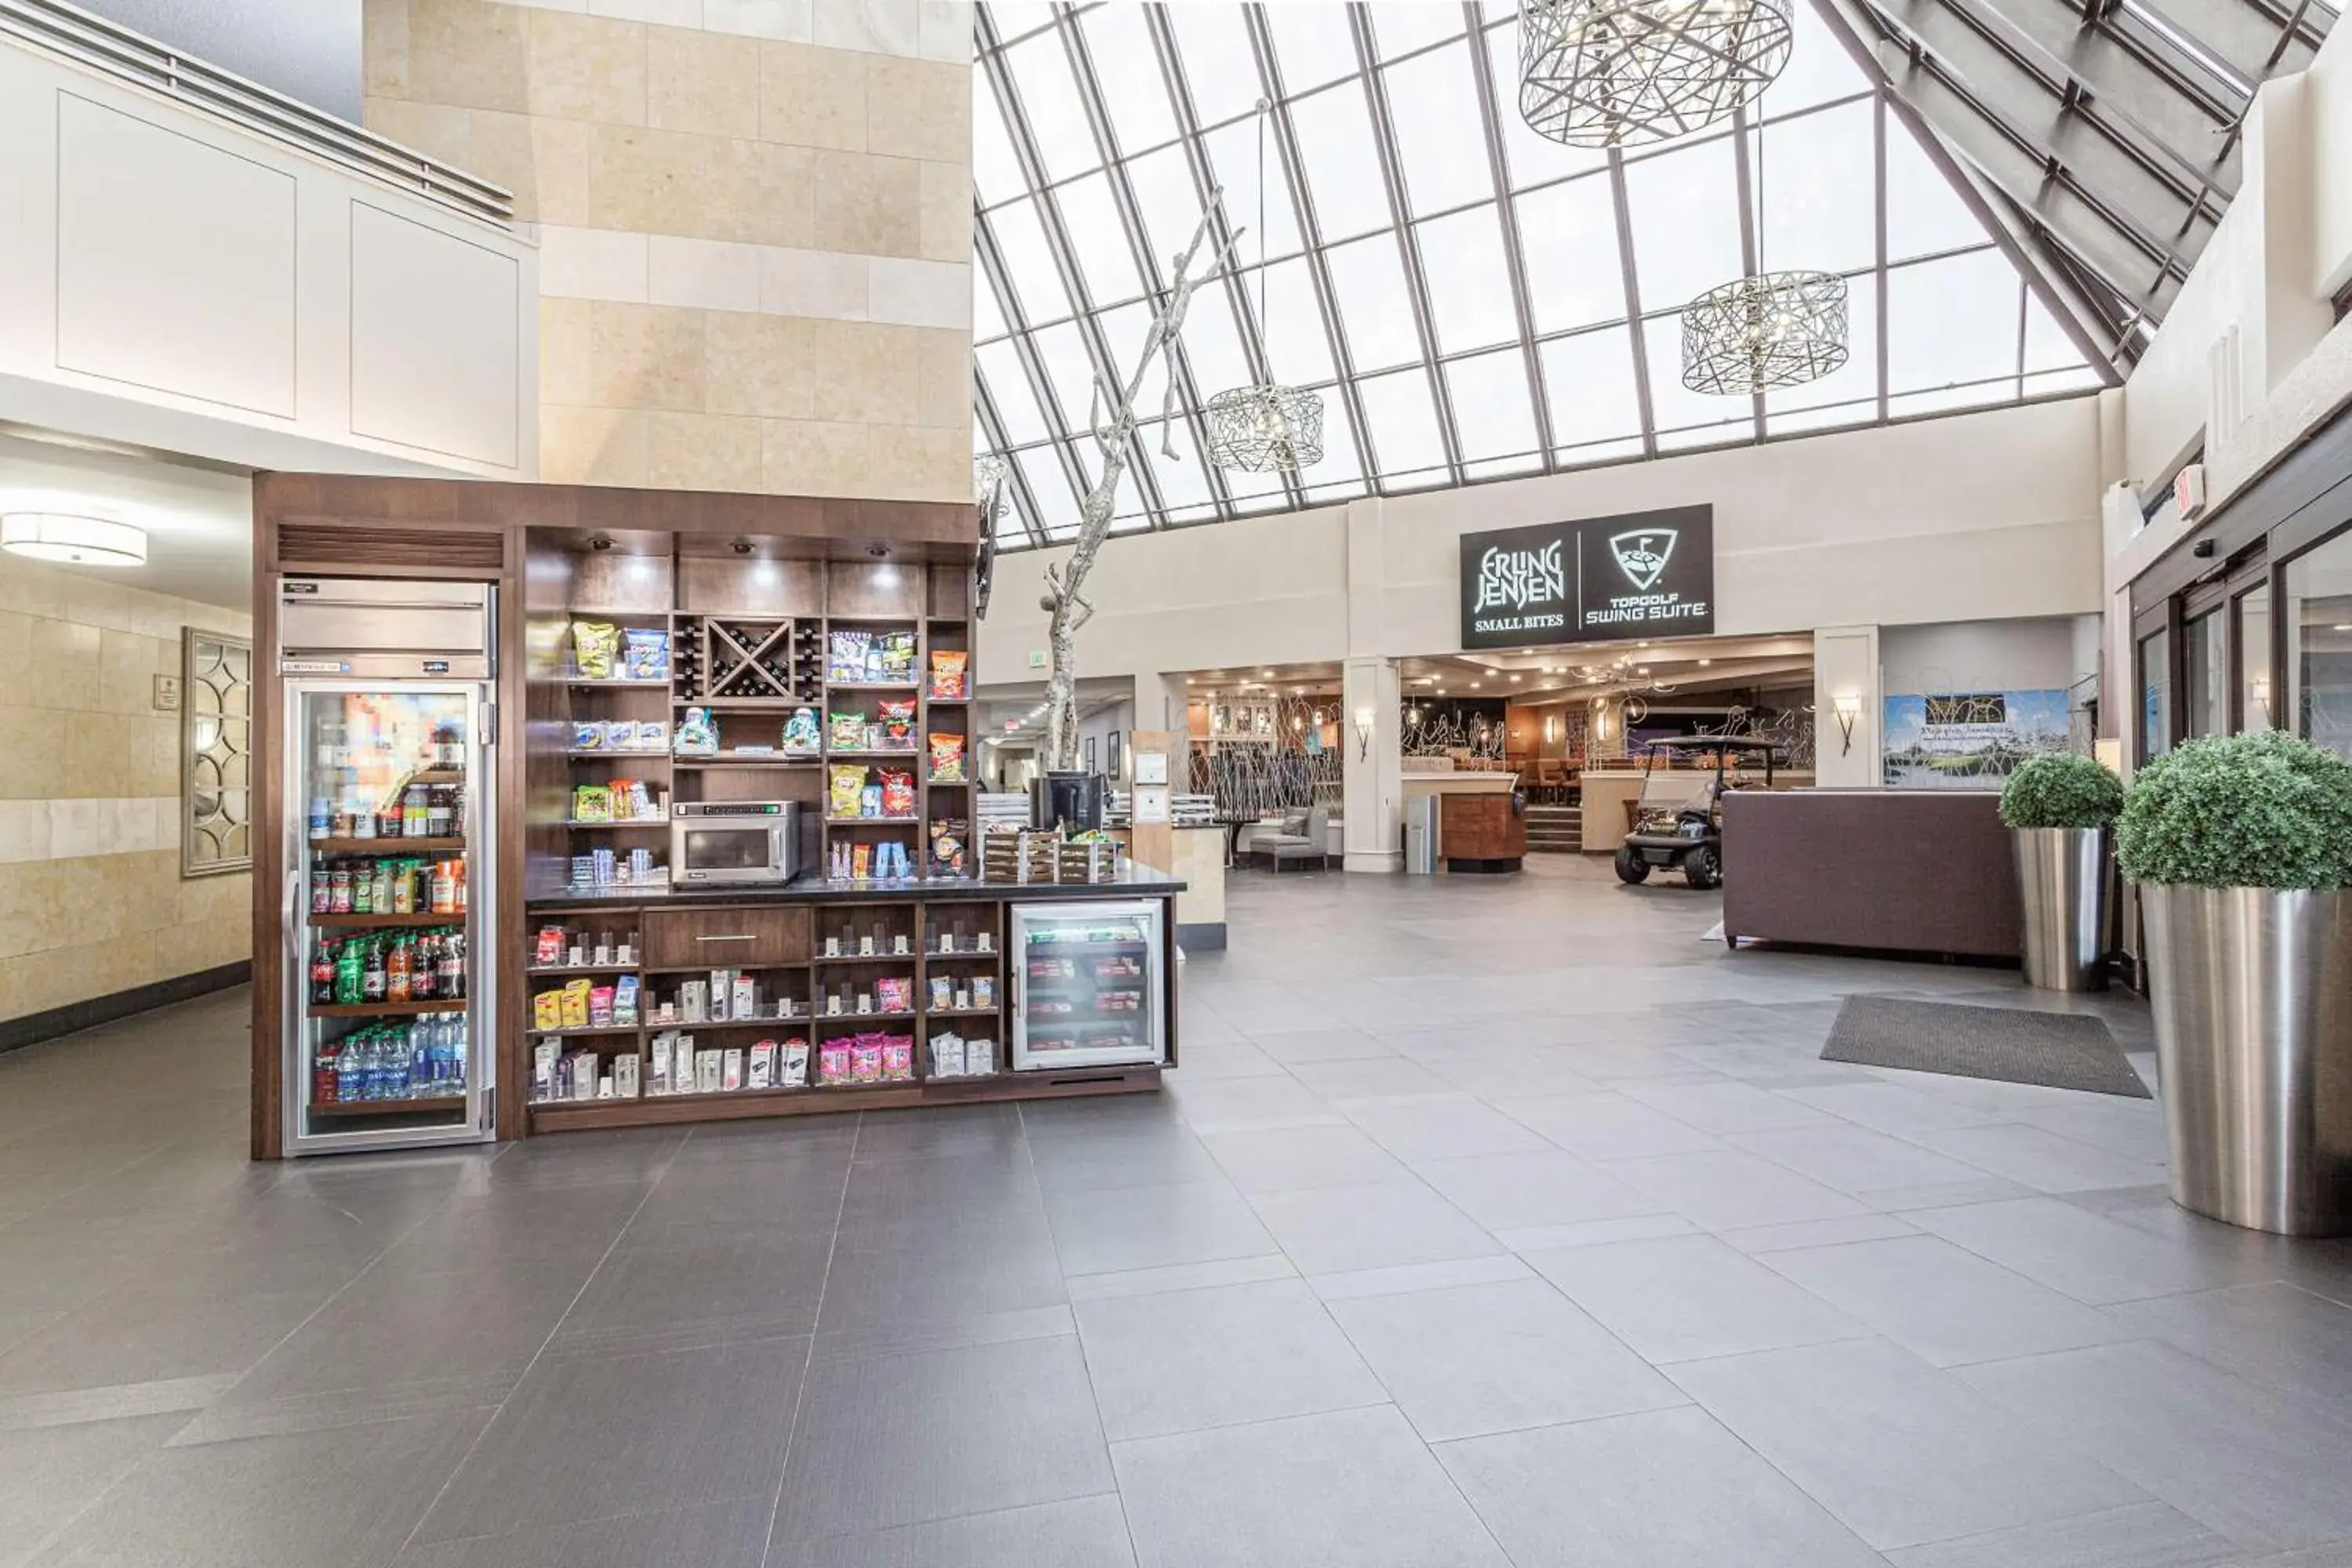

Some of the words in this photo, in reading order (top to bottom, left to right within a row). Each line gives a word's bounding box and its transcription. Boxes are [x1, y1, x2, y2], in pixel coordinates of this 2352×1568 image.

[1482, 539, 1562, 583] ERLING
[1474, 571, 1564, 613] JENSEN
[1610, 593, 1679, 608] TOPGOLF
[1475, 618, 1522, 632] SMALL
[1523, 614, 1564, 629] BITES
[1586, 608, 1644, 624] SWING
[1649, 602, 1706, 619] SUITE
